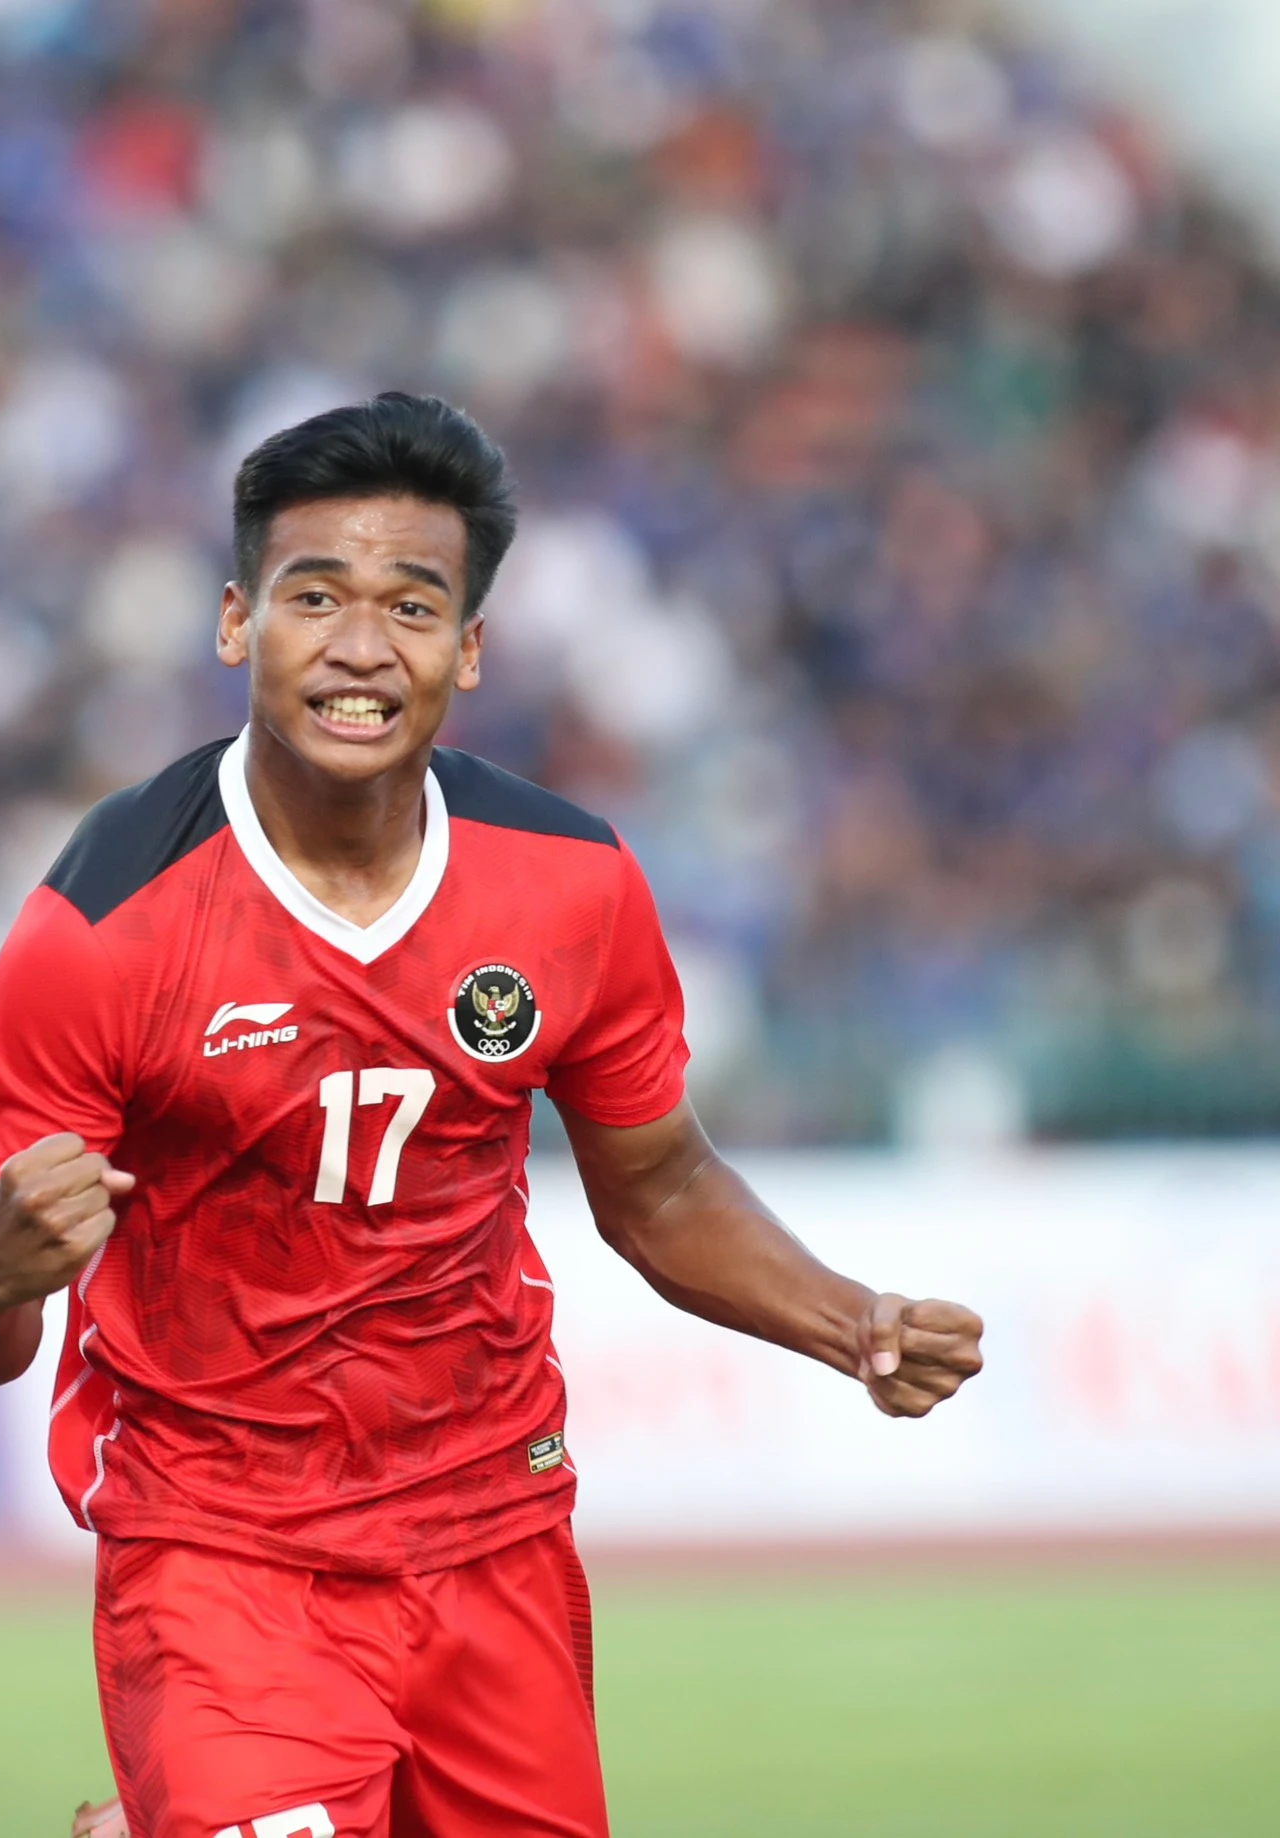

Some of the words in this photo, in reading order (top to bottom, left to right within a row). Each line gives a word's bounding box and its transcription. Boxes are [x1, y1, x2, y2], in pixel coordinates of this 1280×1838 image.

[457, 974, 475, 997] TIM
[475, 964, 534, 1001] INDONESIA
[203, 1025, 299, 1058] LI-NING
[313, 1067, 437, 1207] 17
